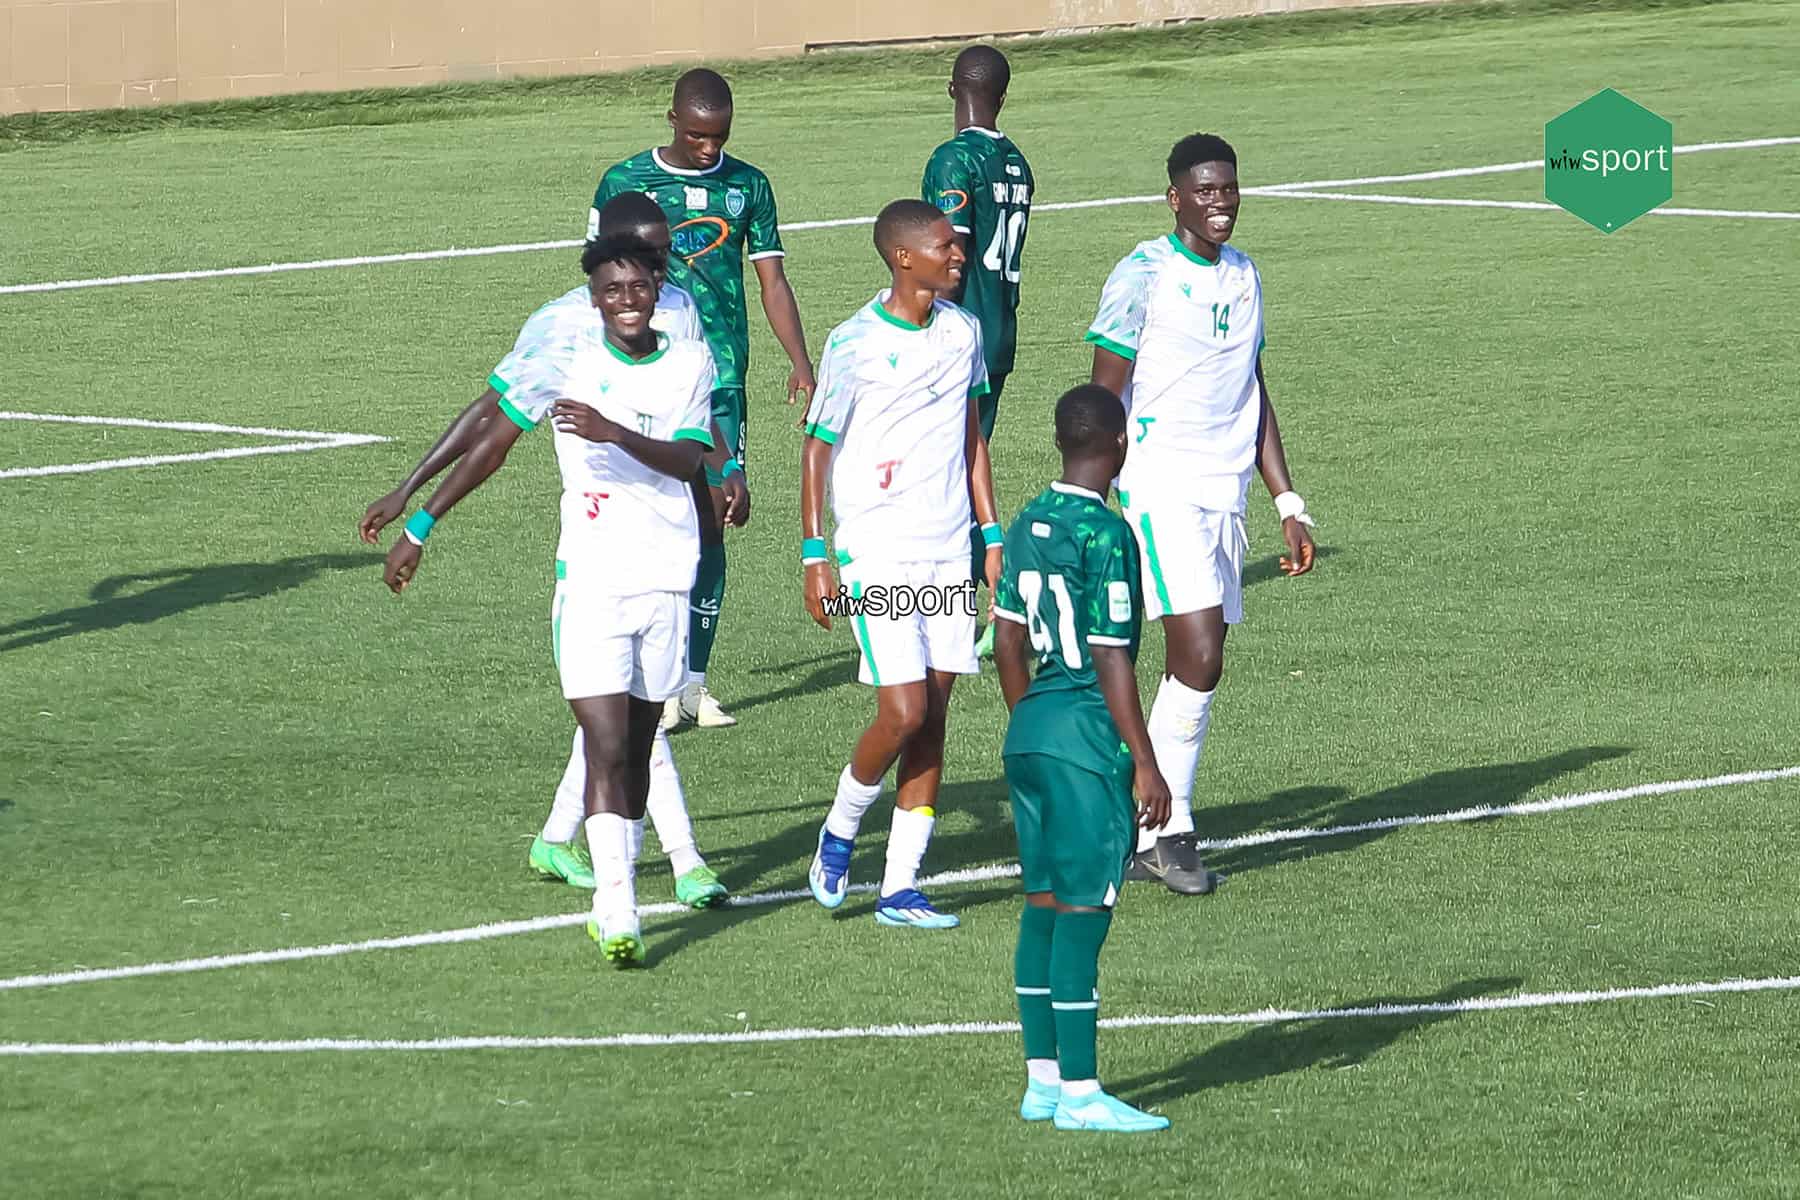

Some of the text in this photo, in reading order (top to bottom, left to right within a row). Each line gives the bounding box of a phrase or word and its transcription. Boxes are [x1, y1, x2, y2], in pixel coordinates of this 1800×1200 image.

[983, 208, 1027, 283] 40
[1211, 302, 1231, 339] 14
[1018, 570, 1083, 670] 41
